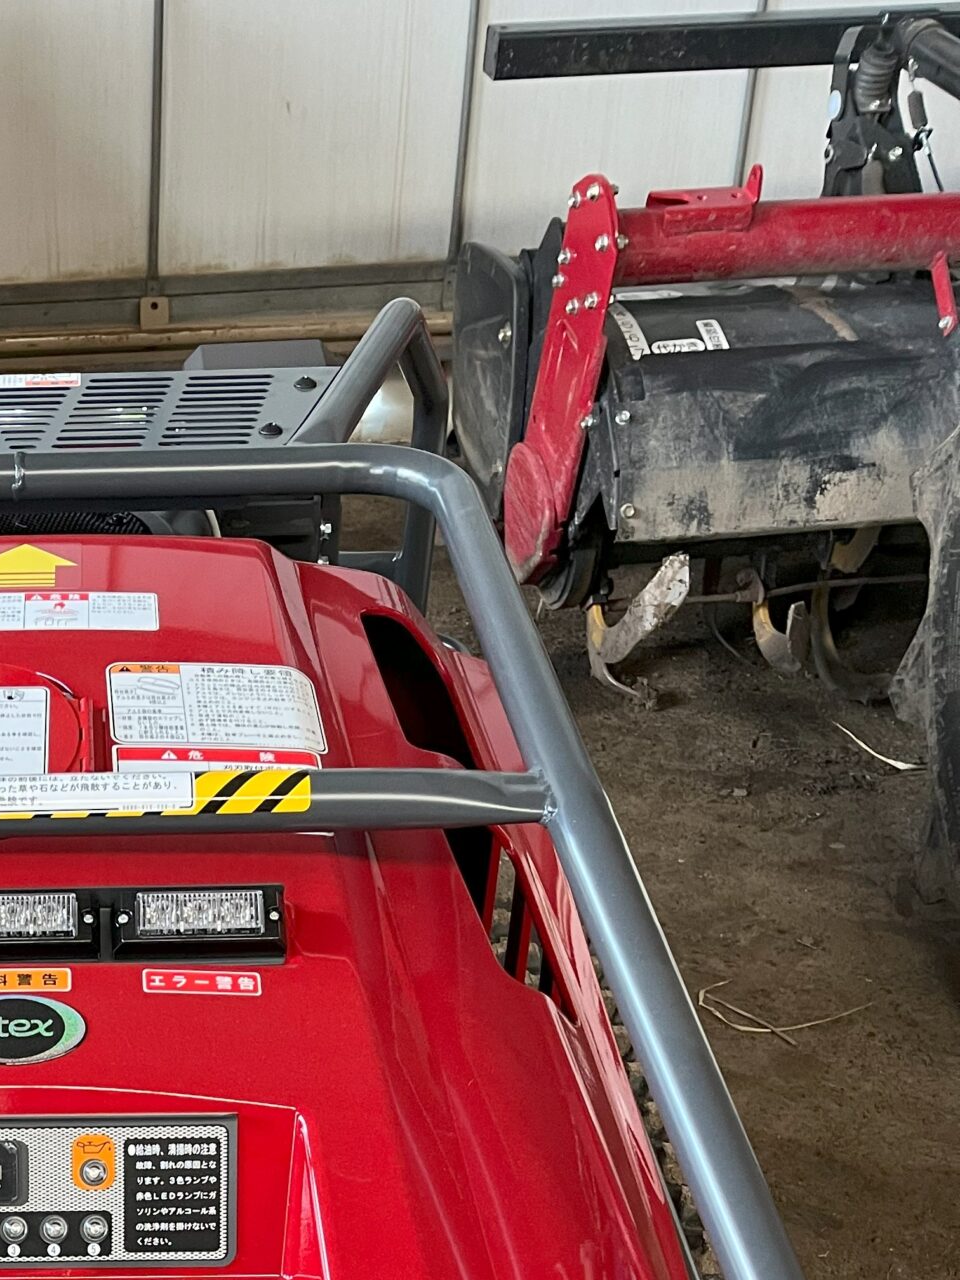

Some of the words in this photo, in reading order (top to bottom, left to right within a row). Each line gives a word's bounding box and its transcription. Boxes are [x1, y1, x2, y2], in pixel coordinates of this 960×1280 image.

[188, 749, 276, 763] 危険
[149, 974, 255, 992] エラー警告
